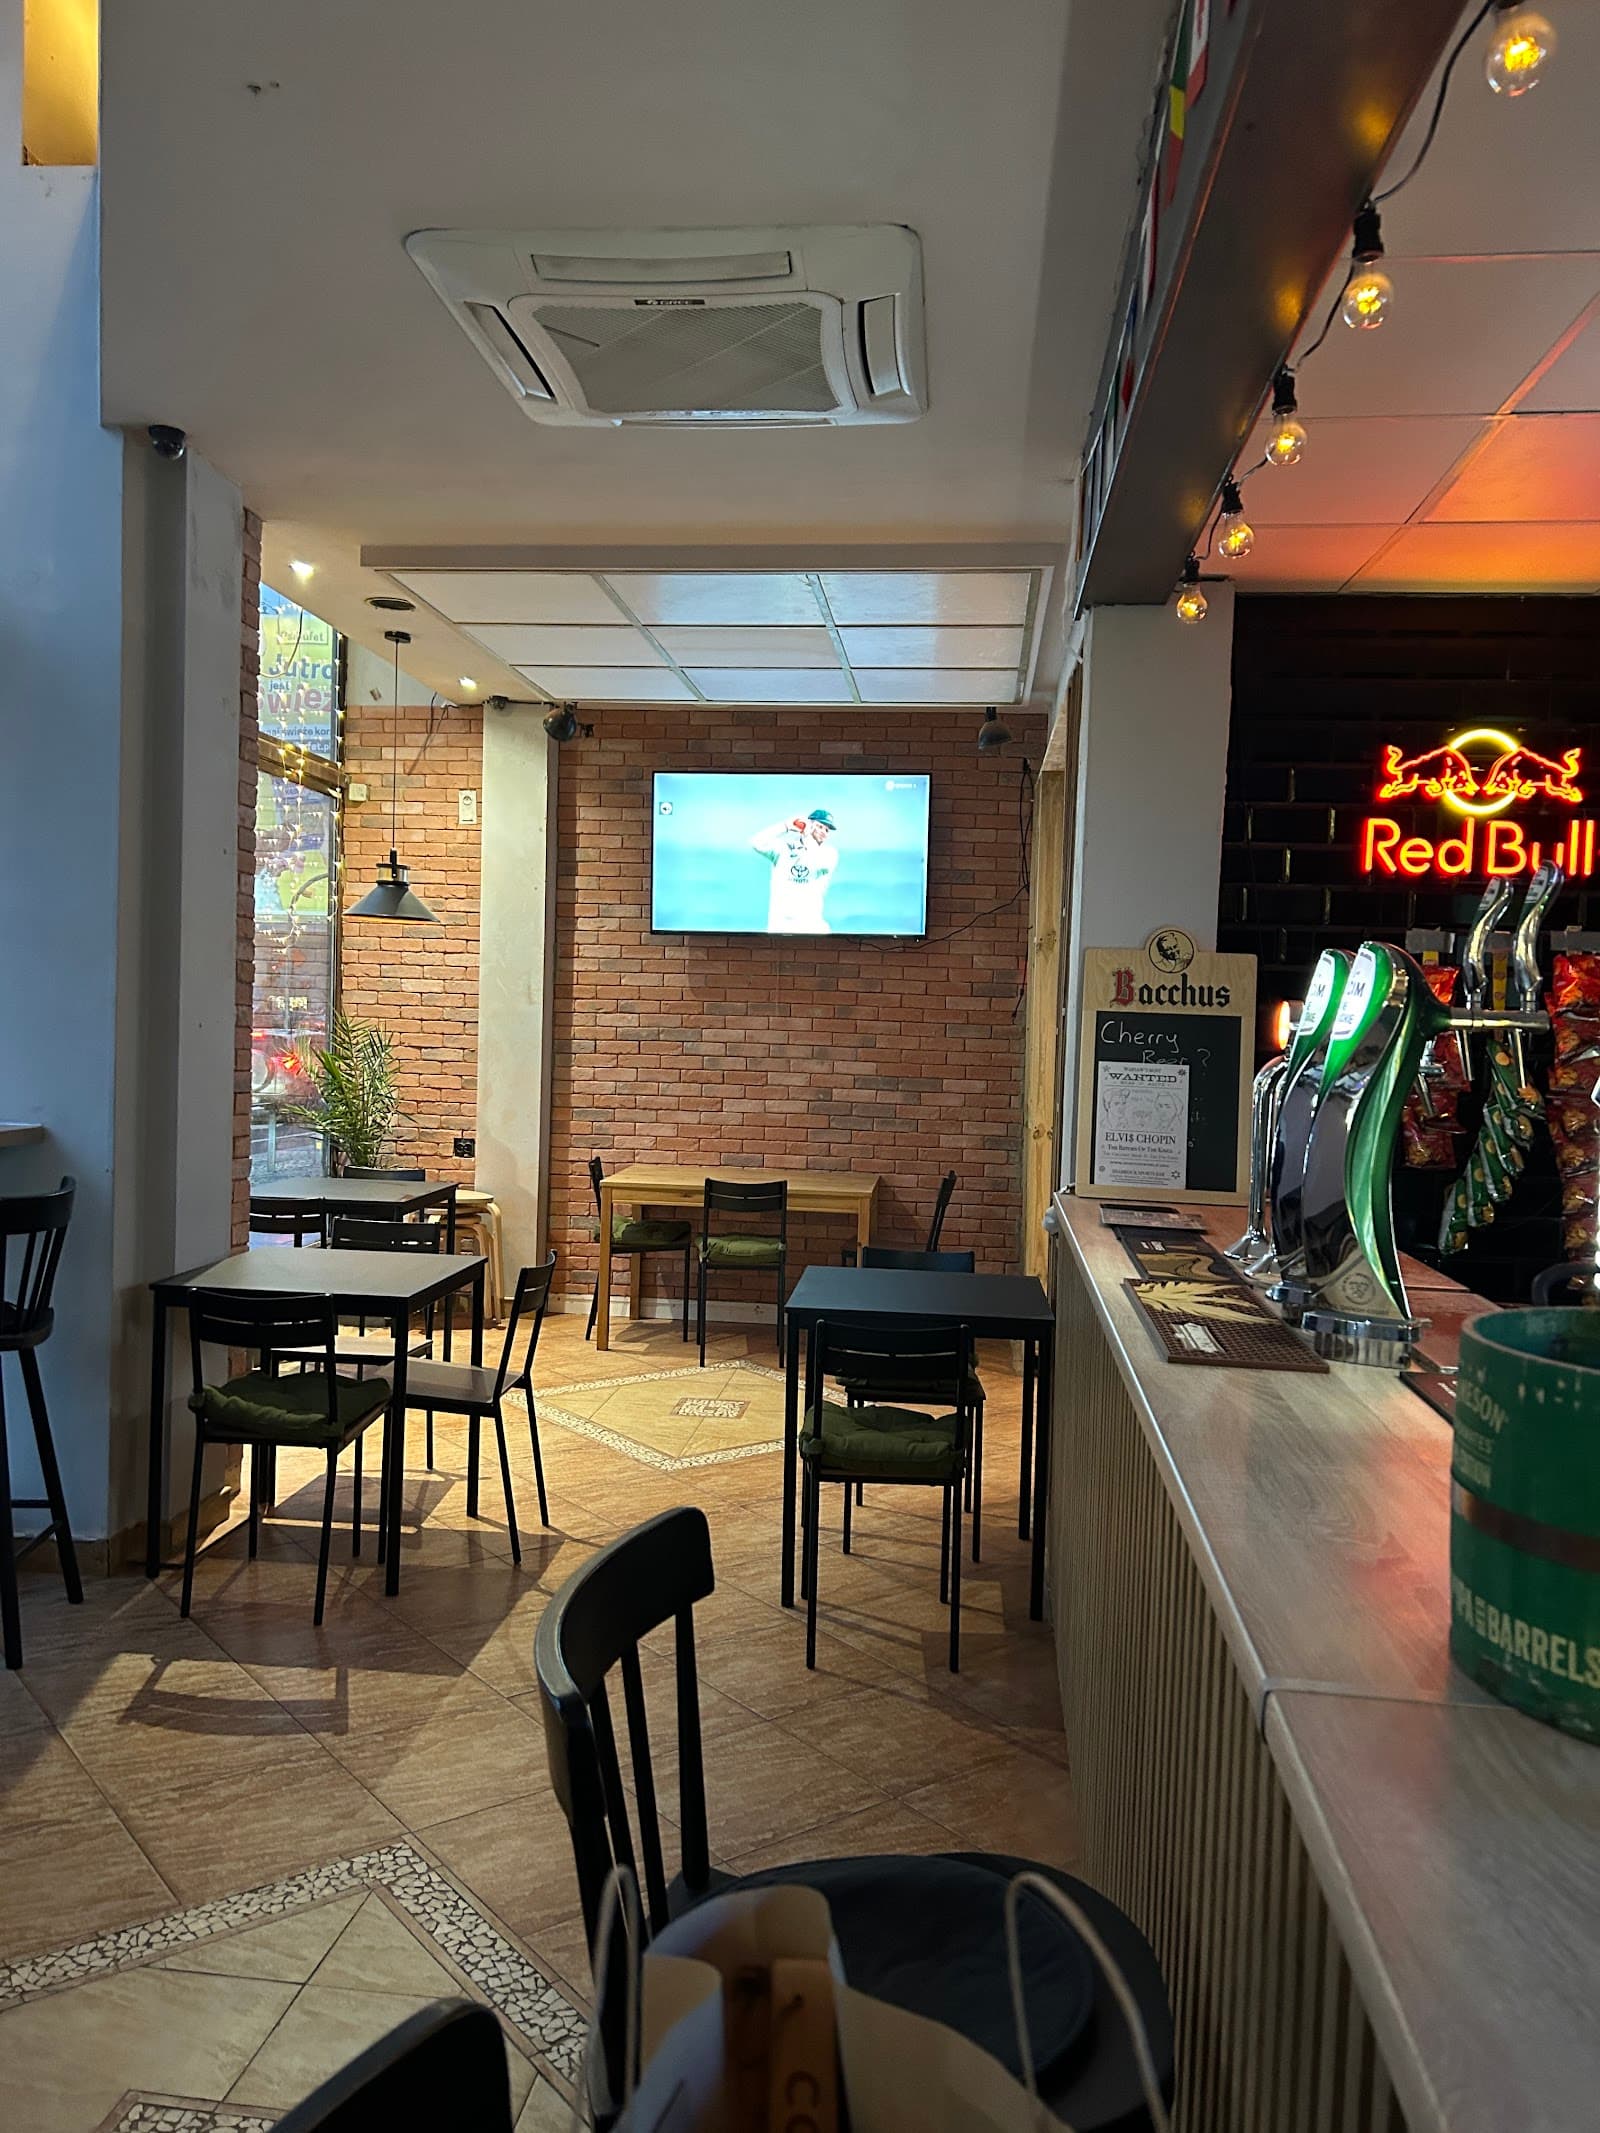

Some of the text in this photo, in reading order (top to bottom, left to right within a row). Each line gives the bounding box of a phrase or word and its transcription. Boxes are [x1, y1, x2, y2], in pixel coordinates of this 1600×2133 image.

[1362, 816, 1596, 876] Red Bull
[1110, 967, 1231, 1008] Bacchus
[1100, 1020, 1179, 1054] Cherry
[1108, 1072, 1178, 1084] WANTED
[1136, 1133, 1177, 1145] CHOPIN
[1487, 1603, 1600, 1690] BARRELS
